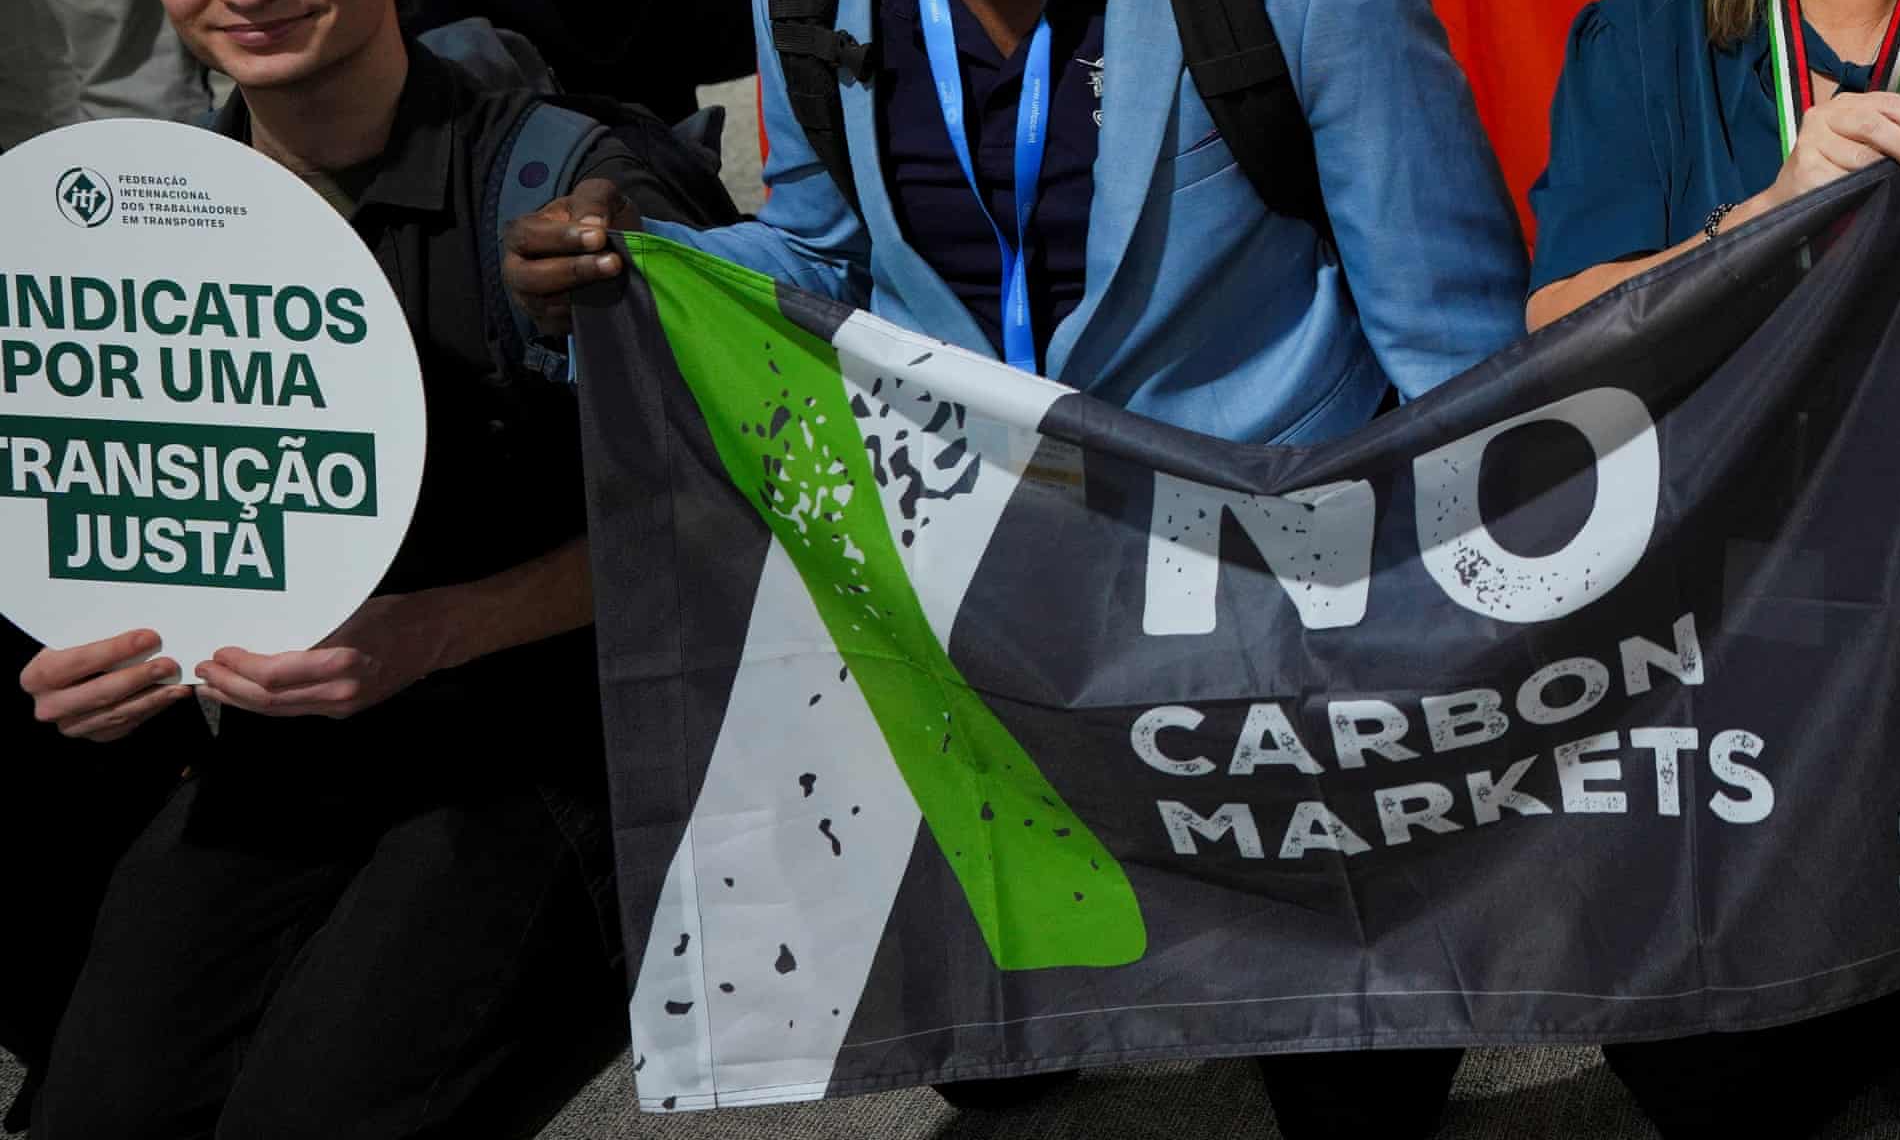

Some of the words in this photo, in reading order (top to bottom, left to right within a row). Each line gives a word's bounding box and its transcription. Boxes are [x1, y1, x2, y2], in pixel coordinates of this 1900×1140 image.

[118, 174, 187, 187] FEDERAÇÃO
[119, 188, 212, 201] INTERNACIONAL
[121, 201, 145, 212] DOS
[149, 203, 248, 216] TRABALHADORES
[122, 215, 139, 225] EM
[143, 216, 225, 229] TRANSPORTES
[0, 339, 144, 400] POR
[159, 346, 327, 409] UMA
[1142, 386, 1661, 636] NO
[67, 513, 274, 579] JUSTA
[1130, 611, 1704, 776] CARBON
[1155, 726, 1776, 859] MARKETS
